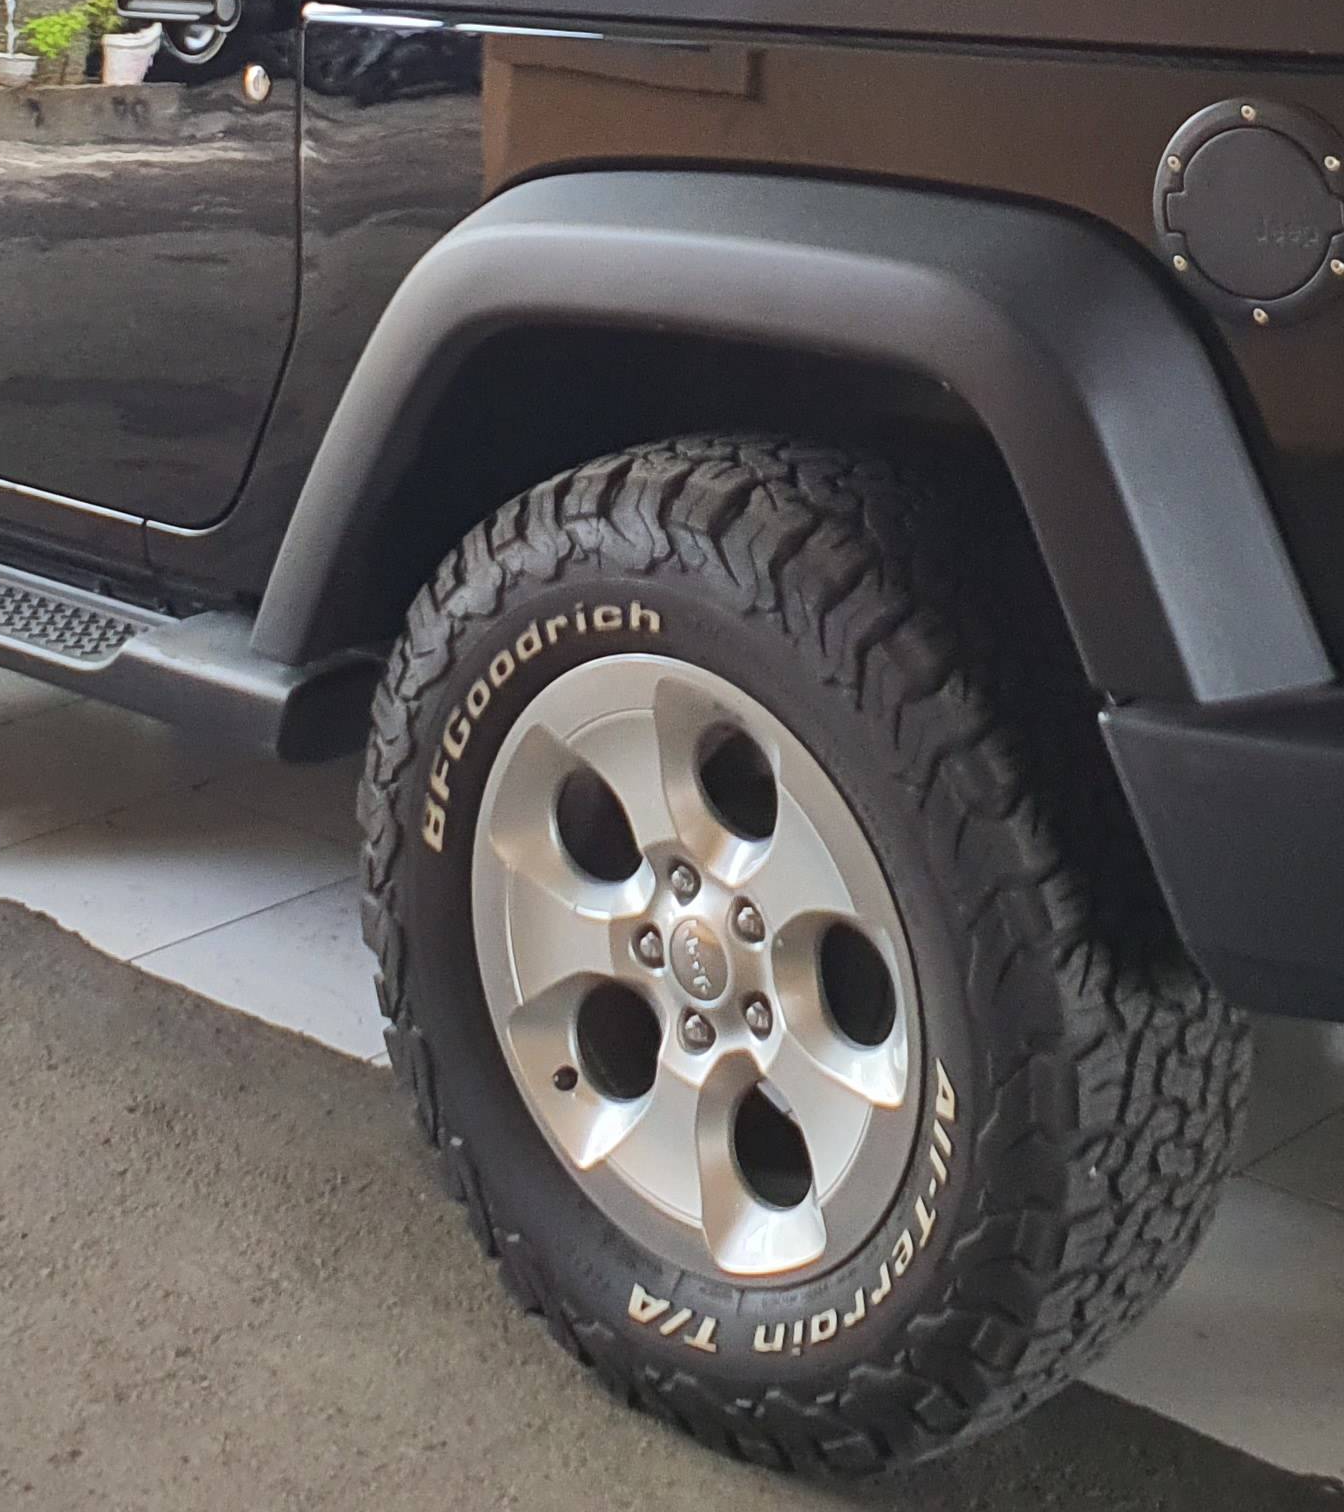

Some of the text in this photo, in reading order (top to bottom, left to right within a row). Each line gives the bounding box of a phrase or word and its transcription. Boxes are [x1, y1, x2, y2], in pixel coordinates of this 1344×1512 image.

[421, 599, 662, 853] BFGoodrich
[627, 1056, 957, 1356] All-Terrain T/A
